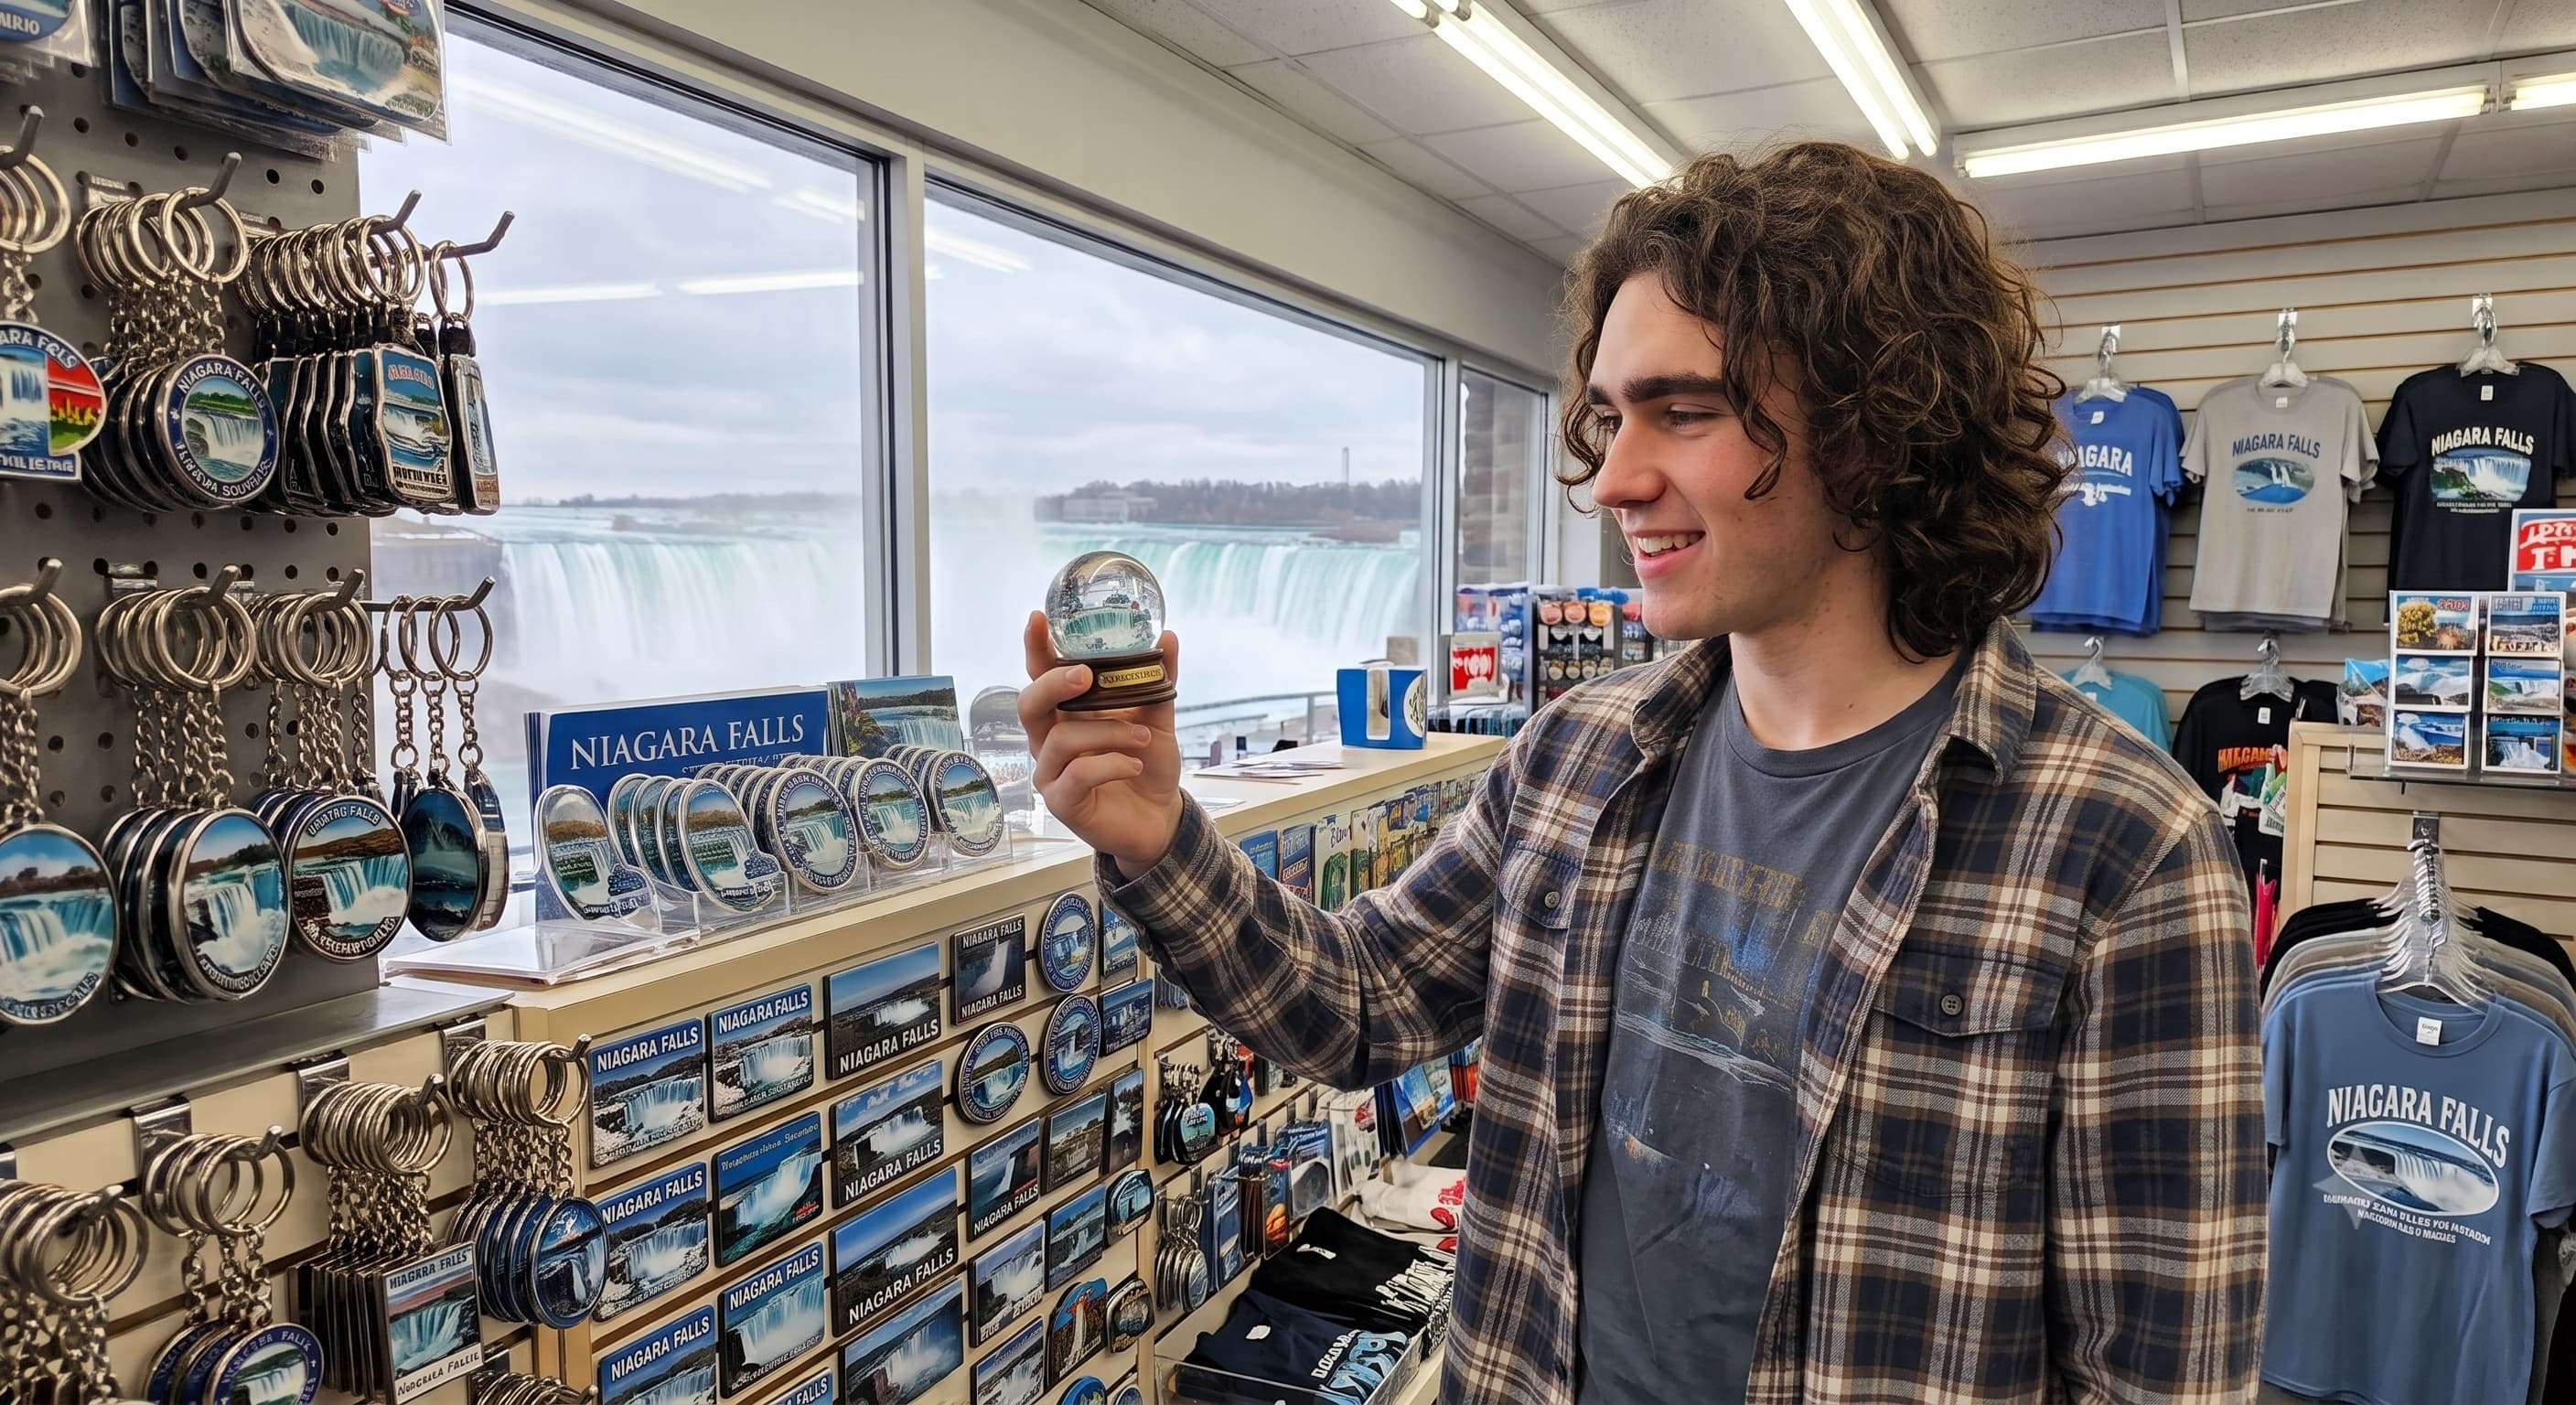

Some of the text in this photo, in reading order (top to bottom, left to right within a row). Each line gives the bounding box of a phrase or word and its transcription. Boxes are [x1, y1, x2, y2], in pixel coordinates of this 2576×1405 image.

[177, 362, 233, 394] NIAGARA
[2232, 433, 2321, 458] NIAGARA FALLS
[2431, 426, 2535, 457] NIAGARA FALLS
[571, 724, 720, 770] NIAGARA
[727, 713, 804, 751] FALLS
[1000, 918, 1023, 938] FALLS
[719, 991, 809, 1035] NIAGARA FALLS
[999, 984, 1023, 1003] FALLS
[596, 1025, 699, 1073] NIAGARA FALLS
[840, 1019, 939, 1073] NIAGARA FALLS
[2326, 1083, 2510, 1169] NIAGARA FALLS
[845, 1161, 904, 1201] NIAGARA
[906, 1139, 941, 1169] FALLS
[601, 1170, 703, 1224] NIAGARA FALLS
[974, 1184, 1038, 1236] NIAGARA FALLS
[729, 1274, 783, 1311] NIAGARA
[786, 1249, 820, 1280] FALLS
[849, 1247, 953, 1325] NIAGARA FALLS
[610, 1315, 710, 1381] NIAGARA FALLS
[796, 1377, 828, 1405] FALLS
